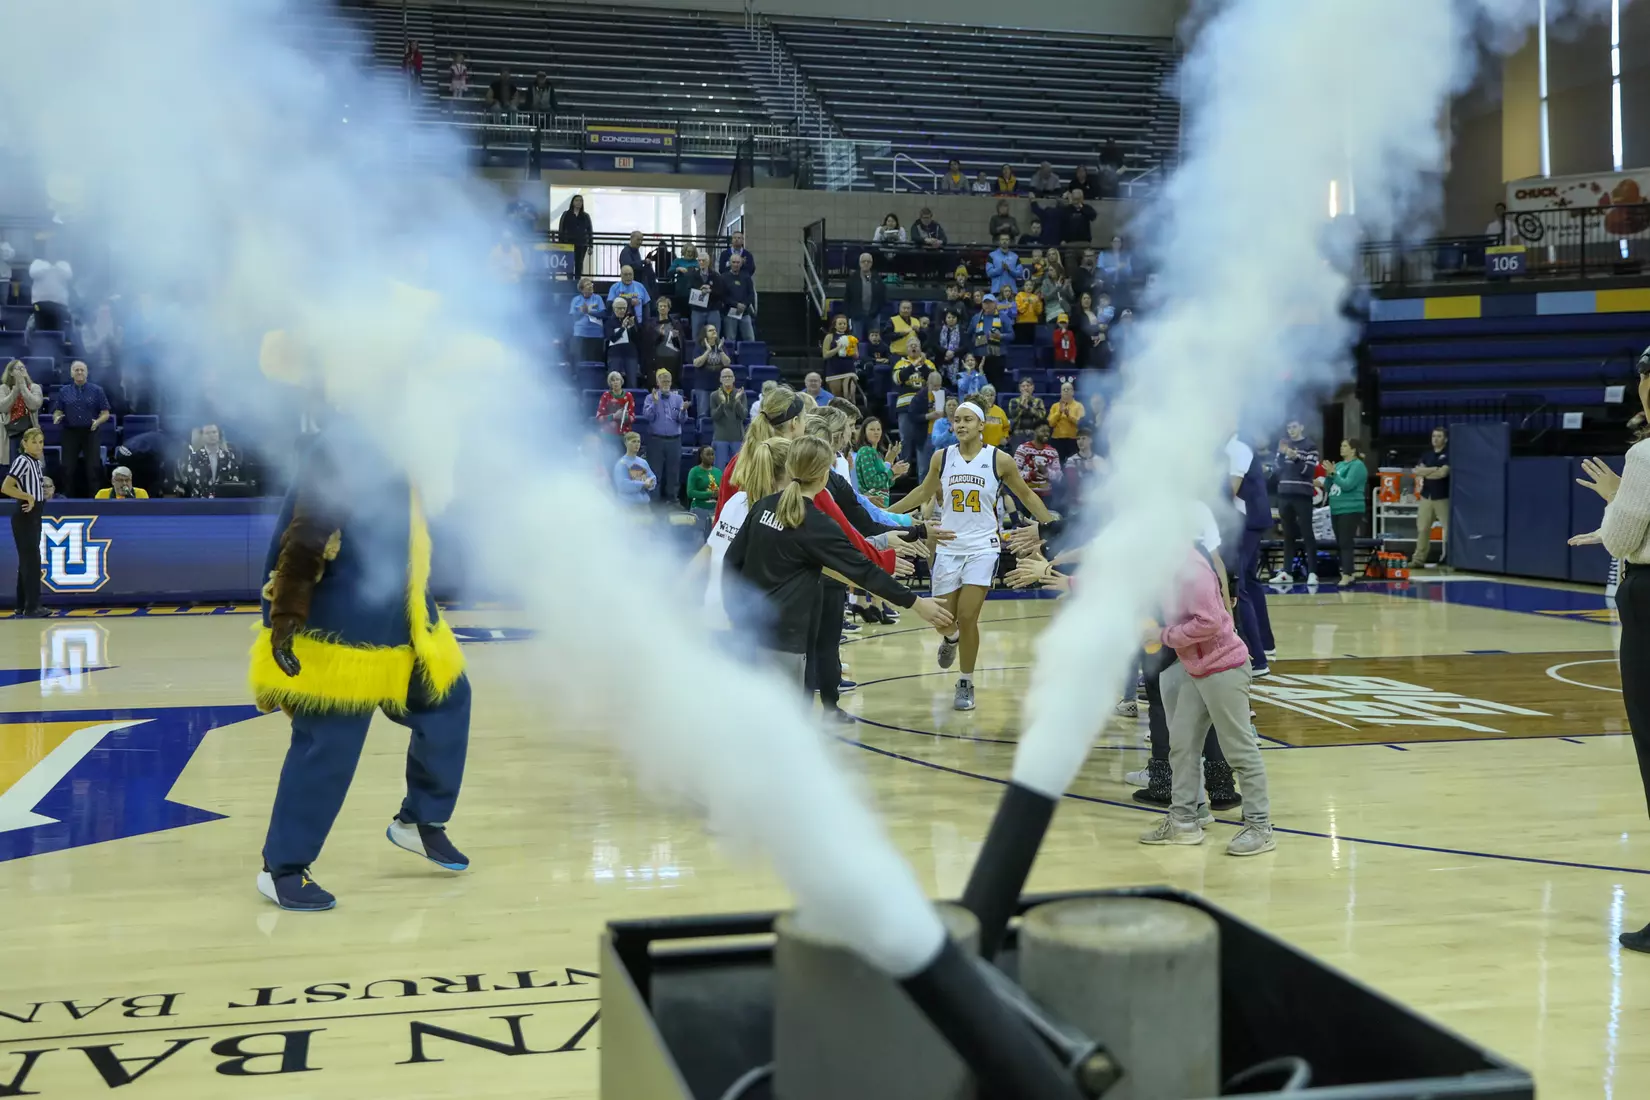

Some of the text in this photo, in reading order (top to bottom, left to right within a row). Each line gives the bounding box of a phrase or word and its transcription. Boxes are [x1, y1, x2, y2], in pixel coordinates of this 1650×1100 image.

[601, 135, 661, 145] CONCESSIONS
[618, 157, 632, 167] EXIT
[1515, 187, 1559, 200] CHUCK
[1492, 255, 1519, 272] 106
[949, 474, 985, 488] MARQUETTE
[951, 489, 981, 513] 24
